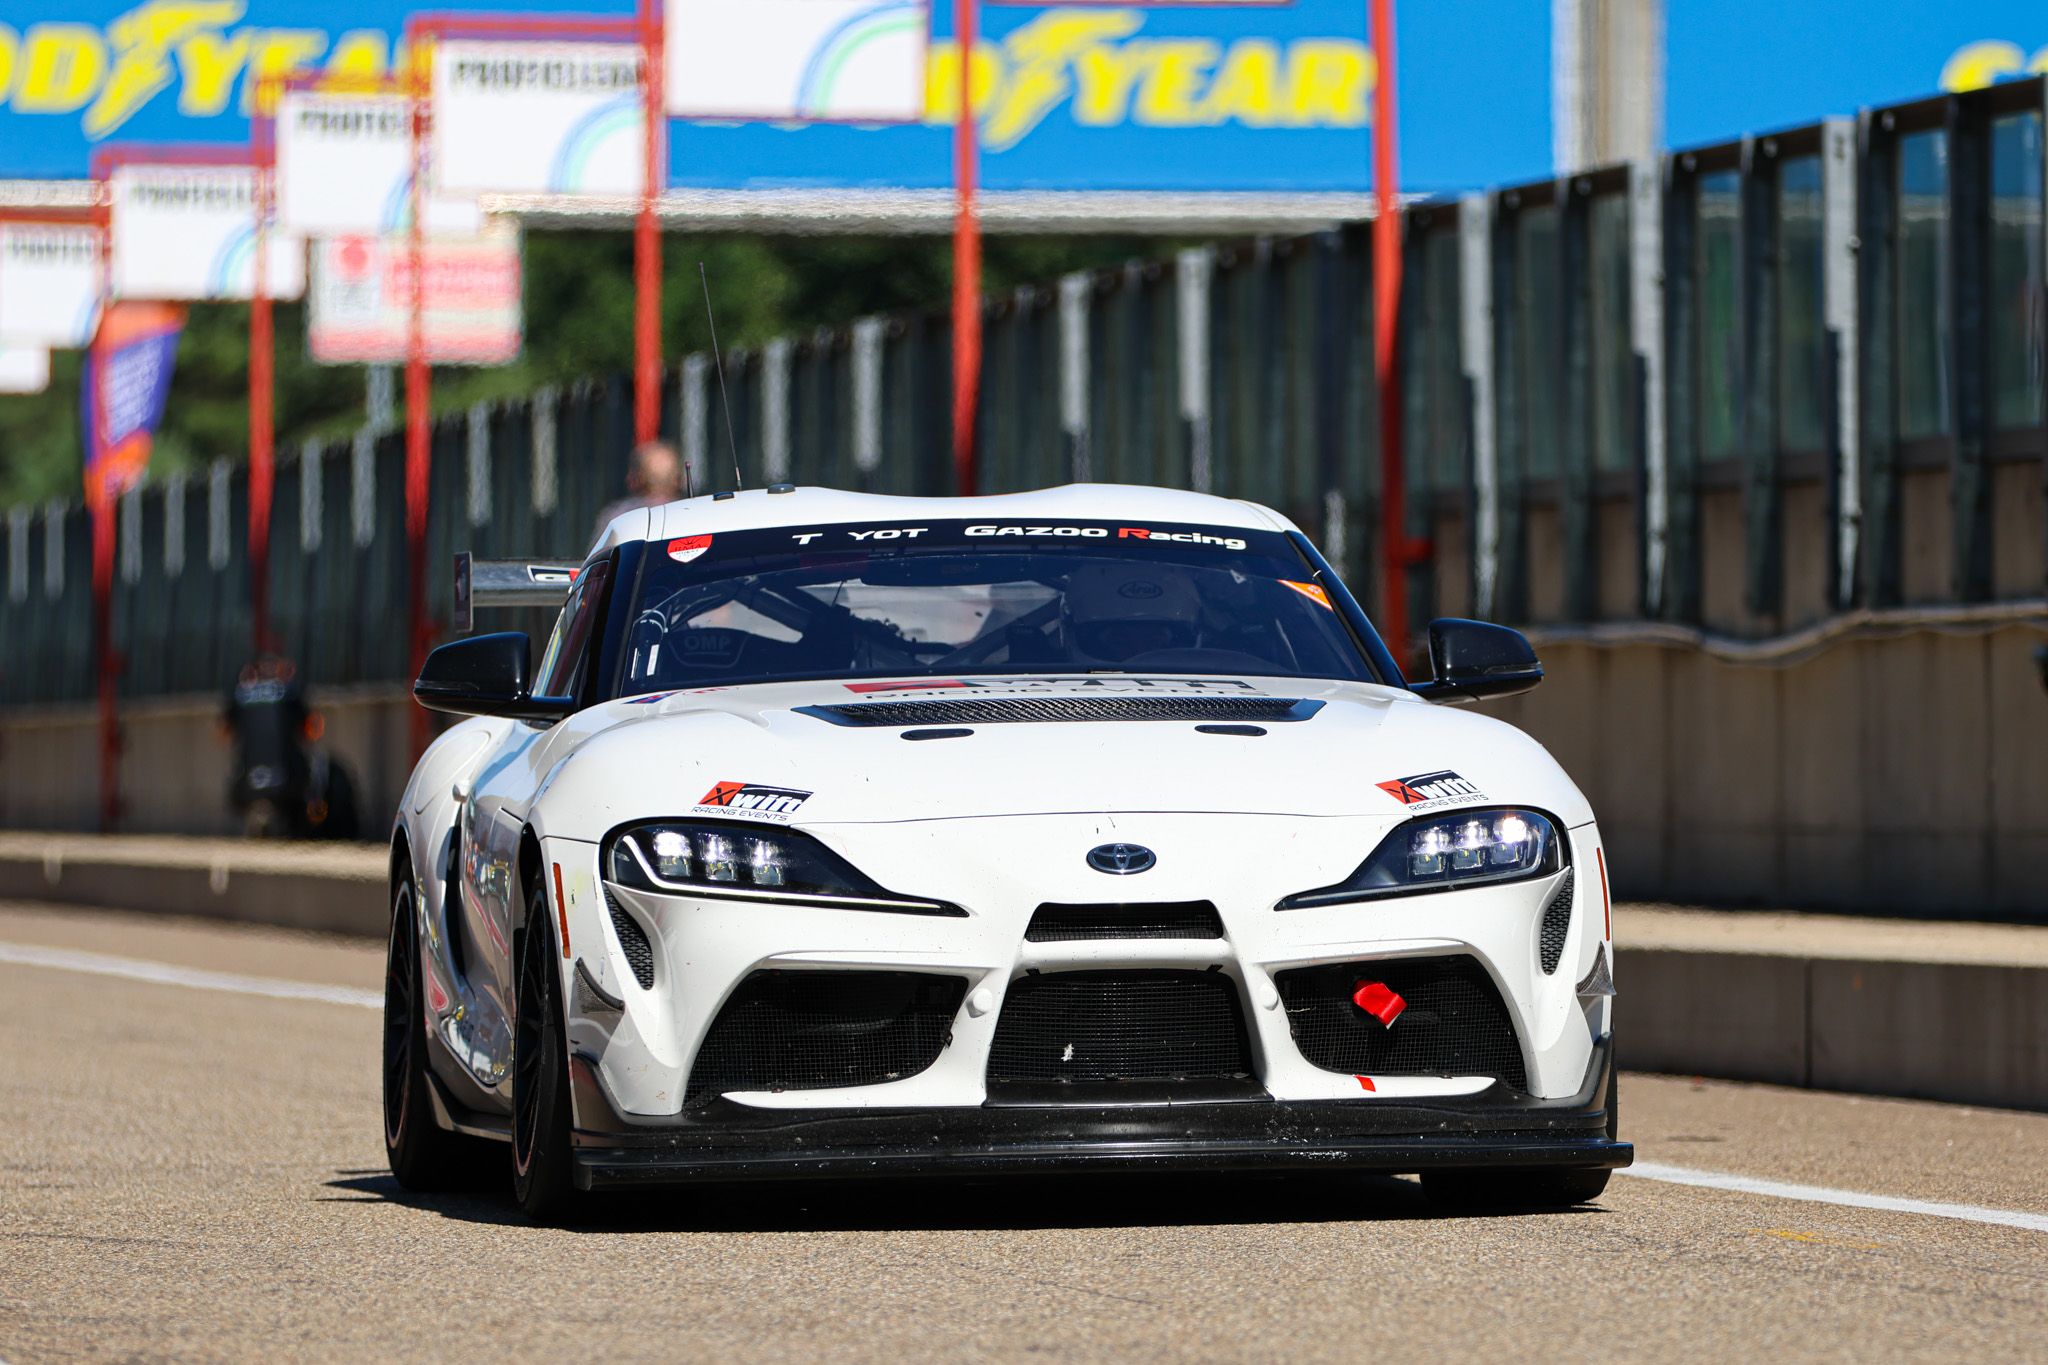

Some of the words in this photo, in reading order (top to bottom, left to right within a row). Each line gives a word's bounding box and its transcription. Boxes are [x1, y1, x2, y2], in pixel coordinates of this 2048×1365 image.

[964, 525, 1109, 538] GAZOO
[1117, 527, 1247, 550] Racing
[684, 635, 730, 650] OMP
[1409, 799, 1449, 812] RACING
[1449, 793, 1489, 805] EVENTS
[691, 806, 736, 816] RACING
[738, 810, 788, 822] EVENTS
